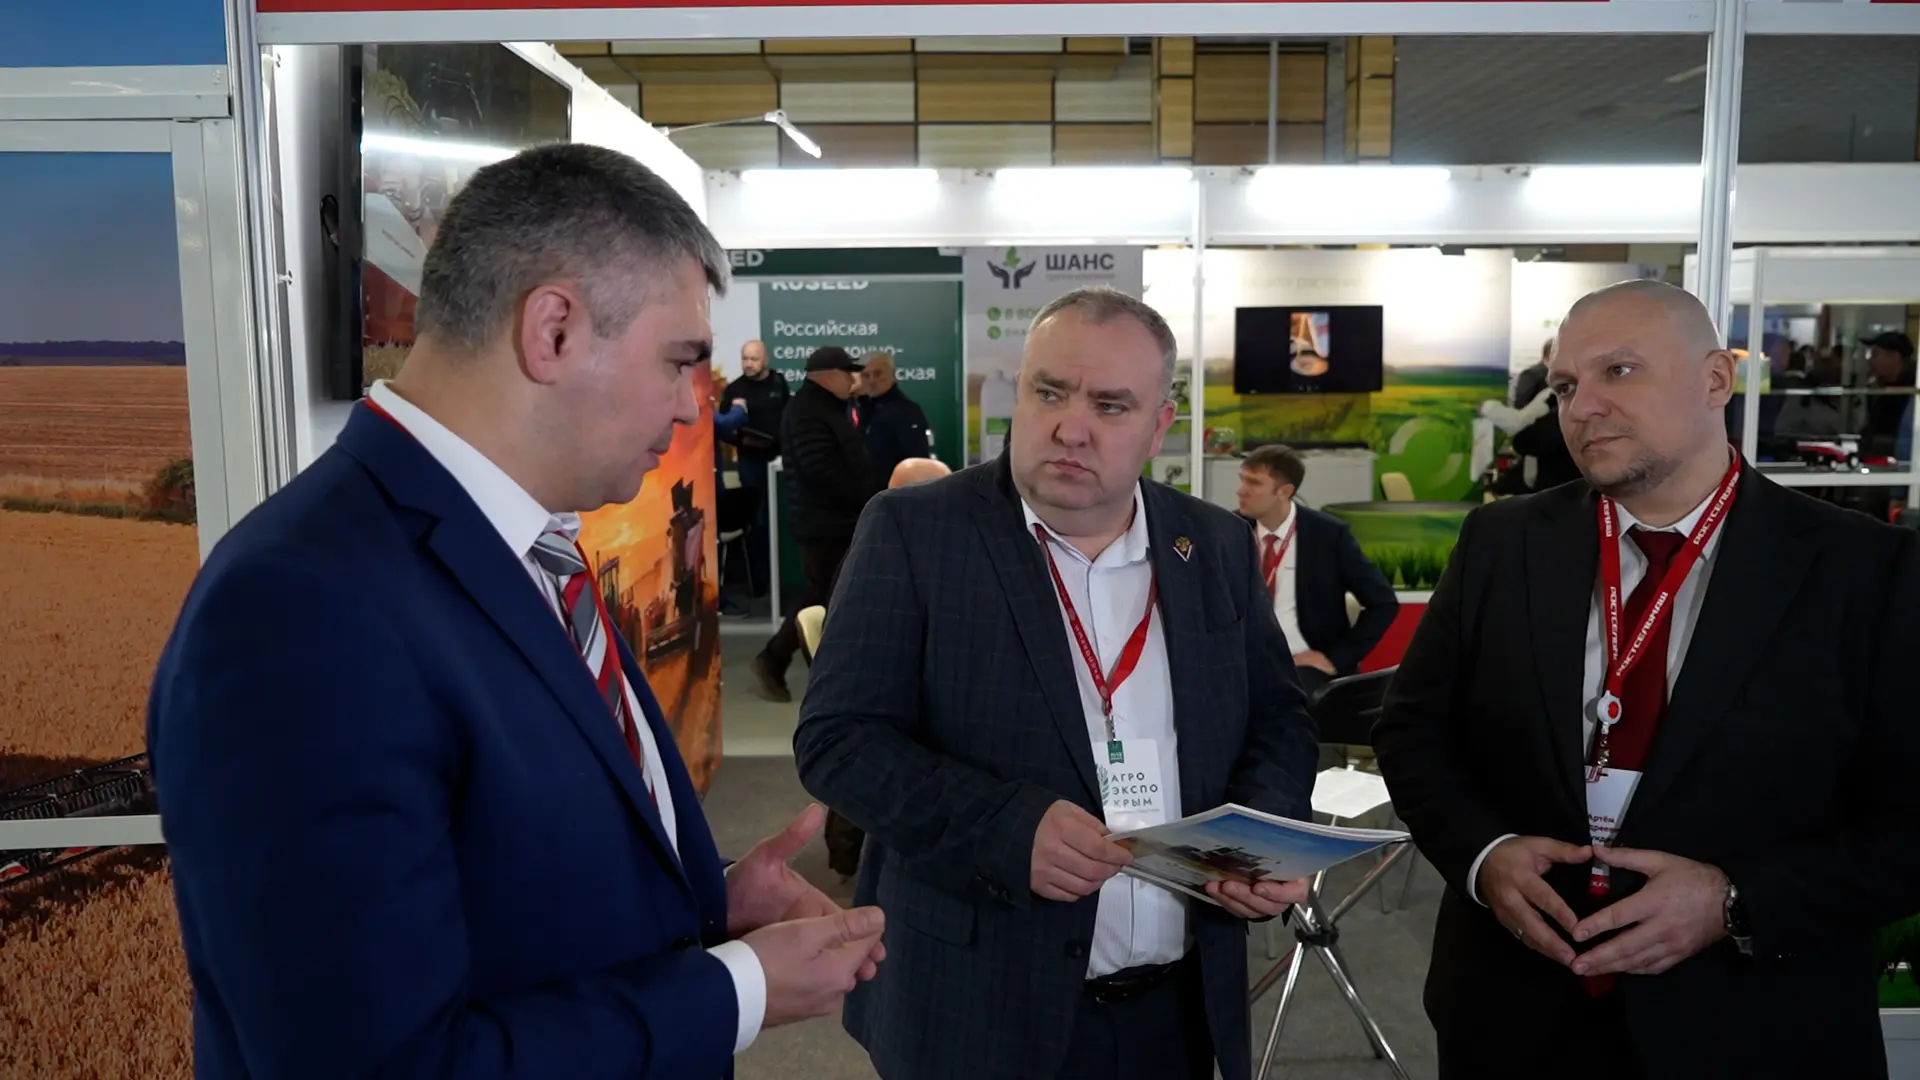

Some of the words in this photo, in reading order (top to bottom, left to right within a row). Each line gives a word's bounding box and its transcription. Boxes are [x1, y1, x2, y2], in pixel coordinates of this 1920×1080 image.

[1046, 254, 1114, 270] ШАНС
[774, 319, 878, 337] Российская
[1111, 771, 1145, 783] АГРО
[1112, 783, 1158, 796] ЭКСПО
[1113, 798, 1153, 808] КРЫМ
